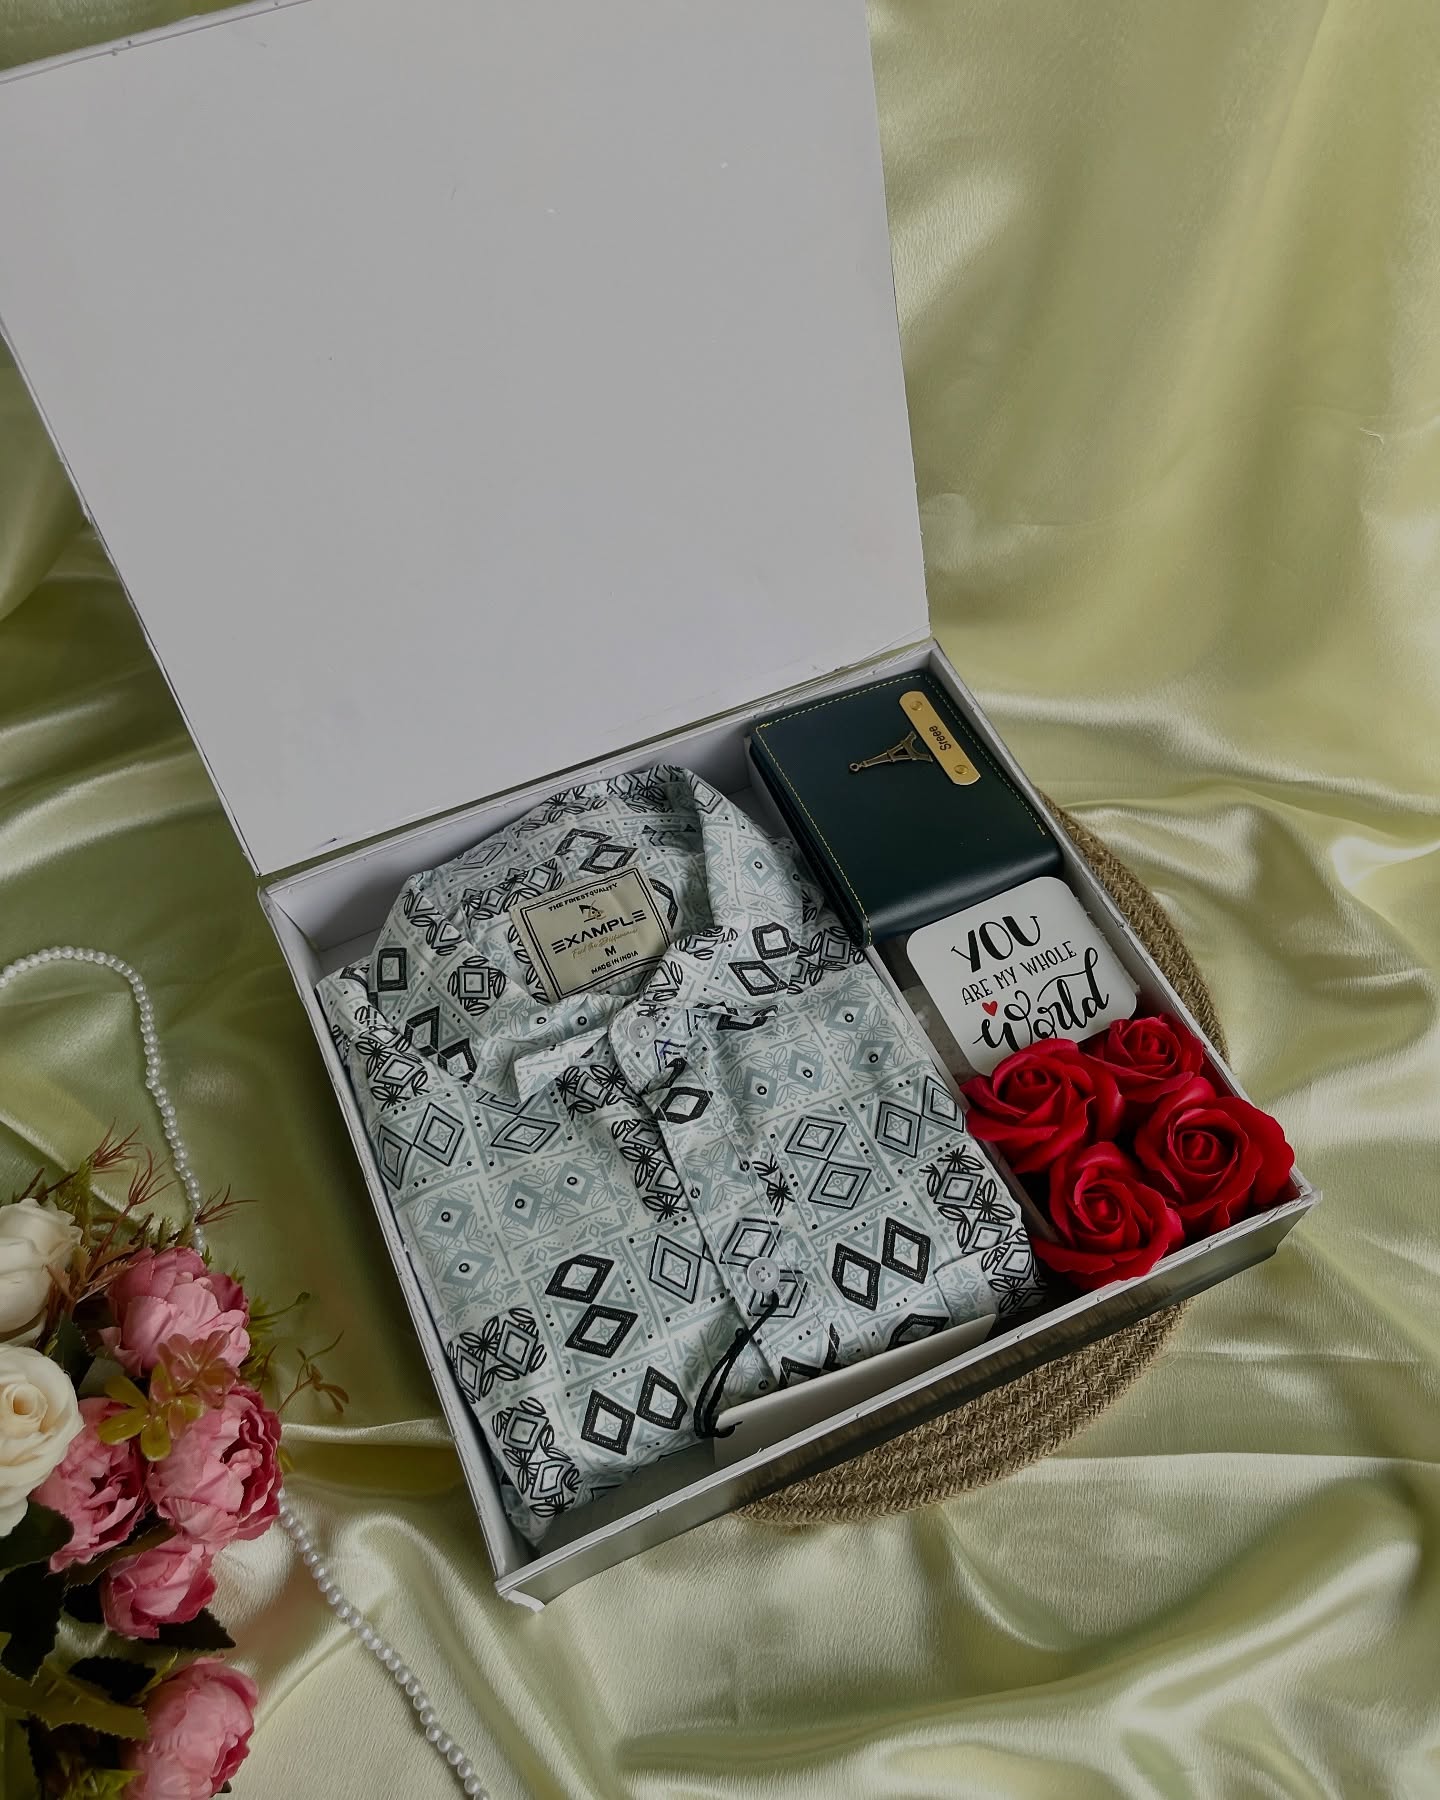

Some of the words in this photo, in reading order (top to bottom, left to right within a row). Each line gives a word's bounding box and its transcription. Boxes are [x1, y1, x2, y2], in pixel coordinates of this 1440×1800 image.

[548, 902, 564, 912] THE
[564, 892, 589, 905] FINEST
[590, 882, 618, 896] QUALITY
[551, 909, 647, 954] EXAMPLE
[604, 944, 617, 957] M
[951, 915, 1041, 973] YOU
[591, 961, 612, 974] MADE
[611, 957, 620, 966] IN
[619, 950, 639, 962] INDIA
[961, 978, 993, 1005] ARE
[993, 966, 1018, 989] MY
[1019, 940, 1077, 976] WHOLE
[972, 947, 1110, 1052] World
